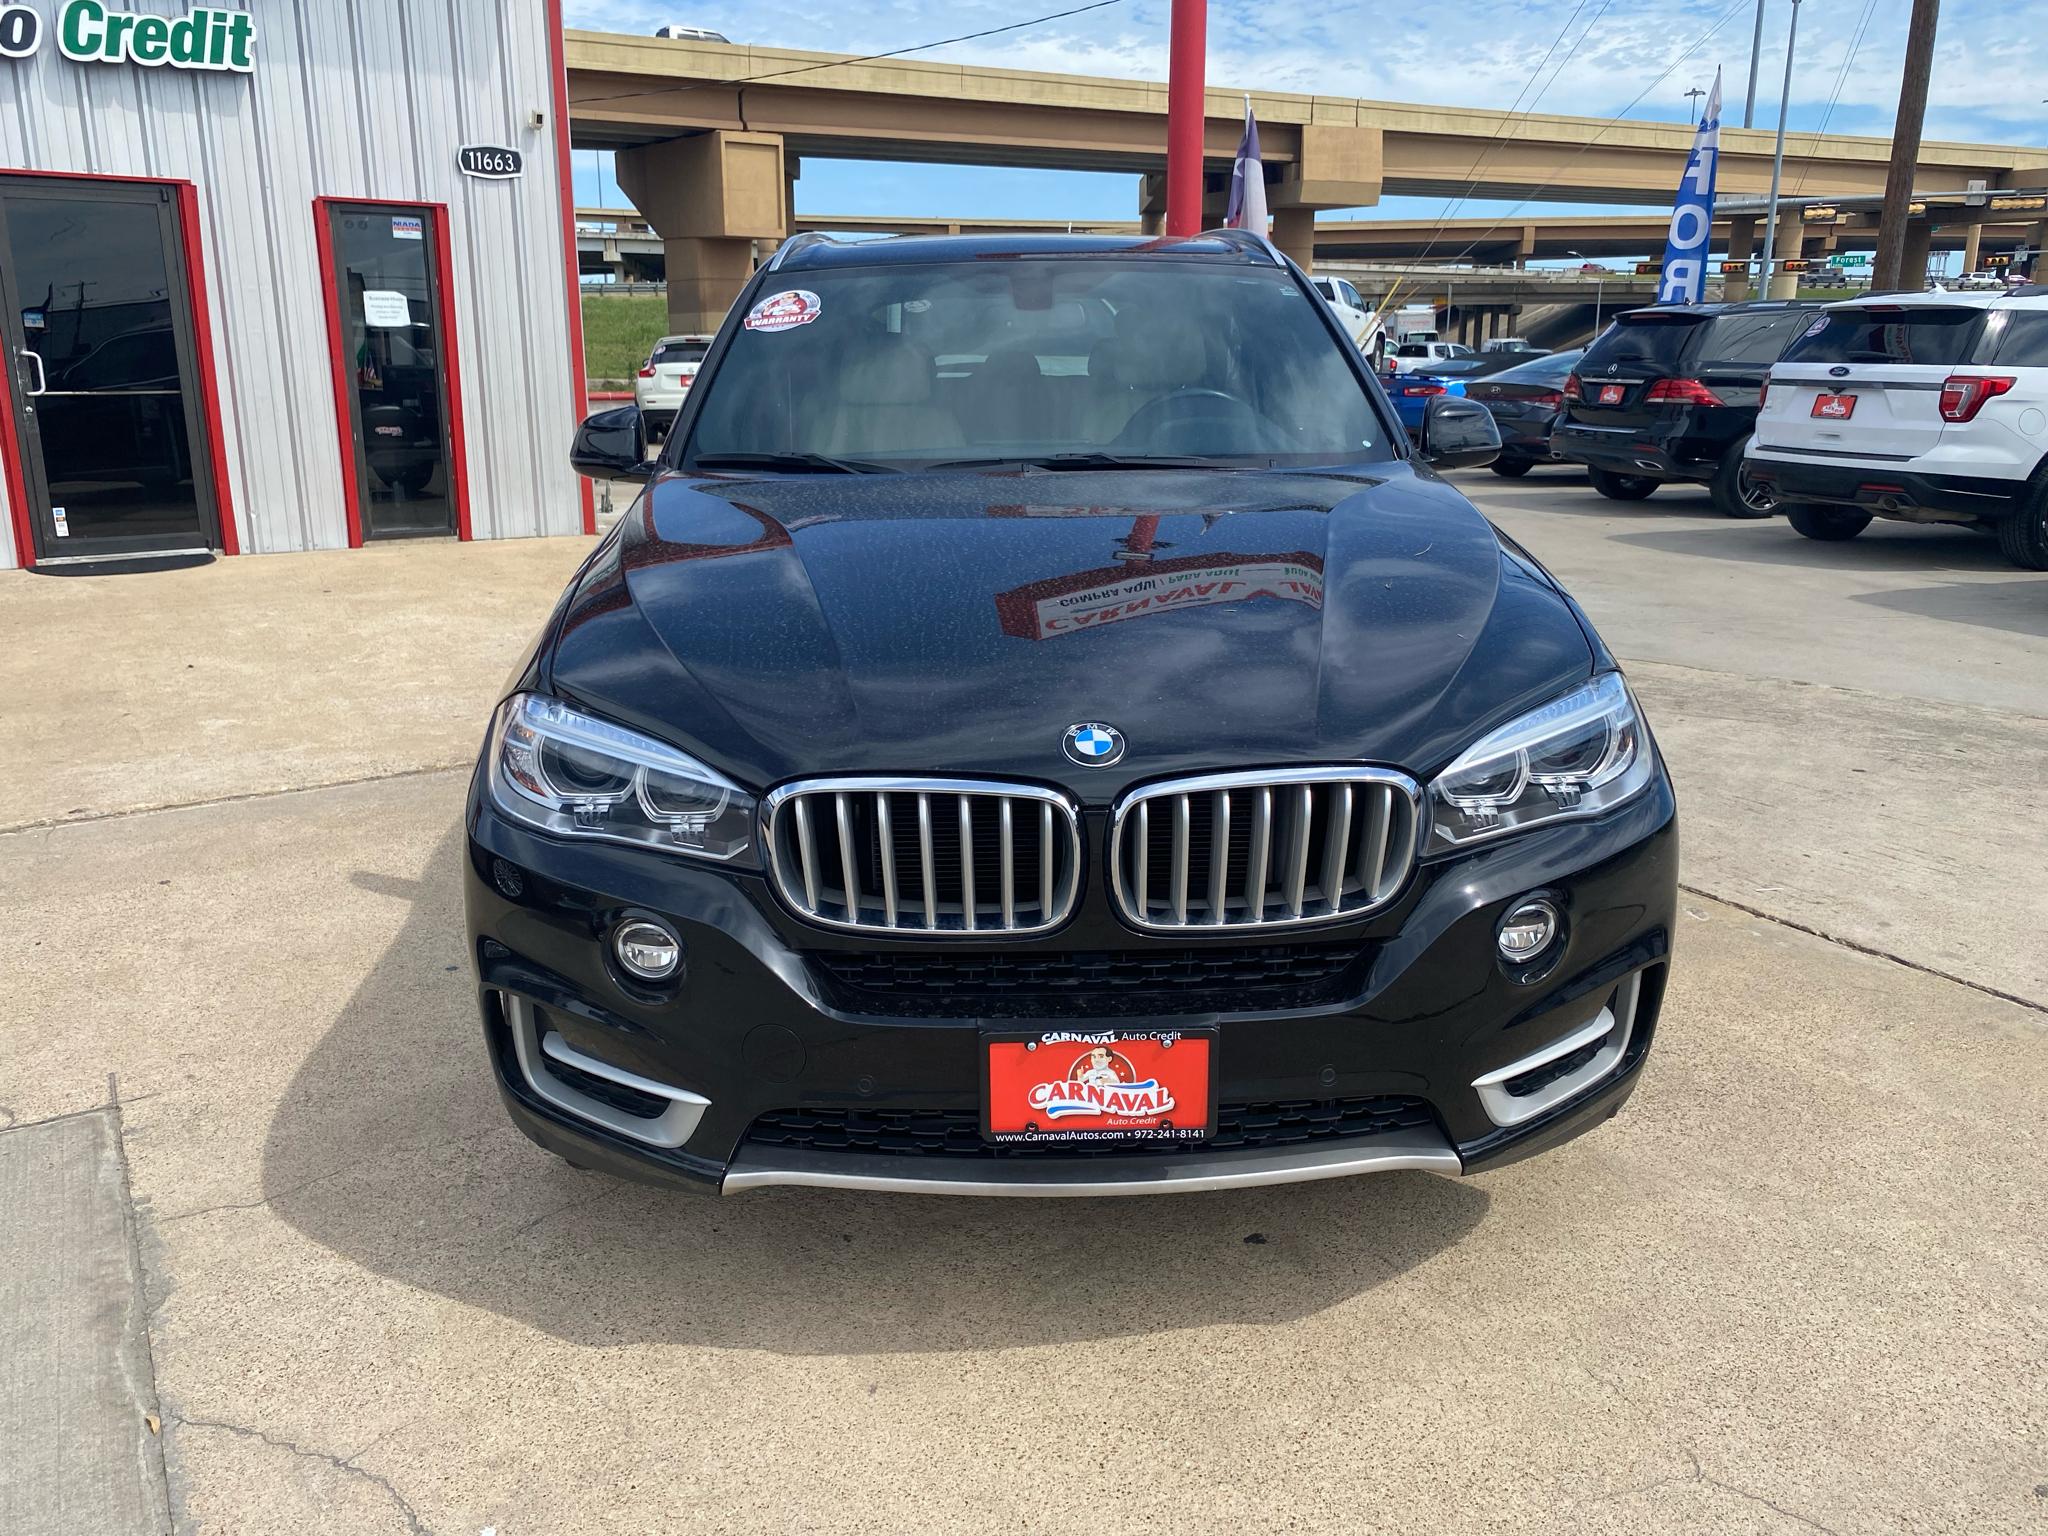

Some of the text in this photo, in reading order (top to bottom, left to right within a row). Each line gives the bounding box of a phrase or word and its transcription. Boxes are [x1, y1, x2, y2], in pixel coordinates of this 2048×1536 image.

[61, 0, 253, 68] Credit
[468, 151, 514, 172] 11663
[1835, 256, 1862, 264] Forest
[750, 314, 811, 327] WARRANTY
[1069, 723, 1118, 736] BMW
[1041, 1030, 1182, 1045] CARNAVAL Auto Credit
[1028, 1081, 1173, 1114] CARNAVAL
[1107, 1117, 1157, 1125] Auto Credit
[995, 1129, 1204, 1142] www.CarnavalAutos.com 972-241-8141
